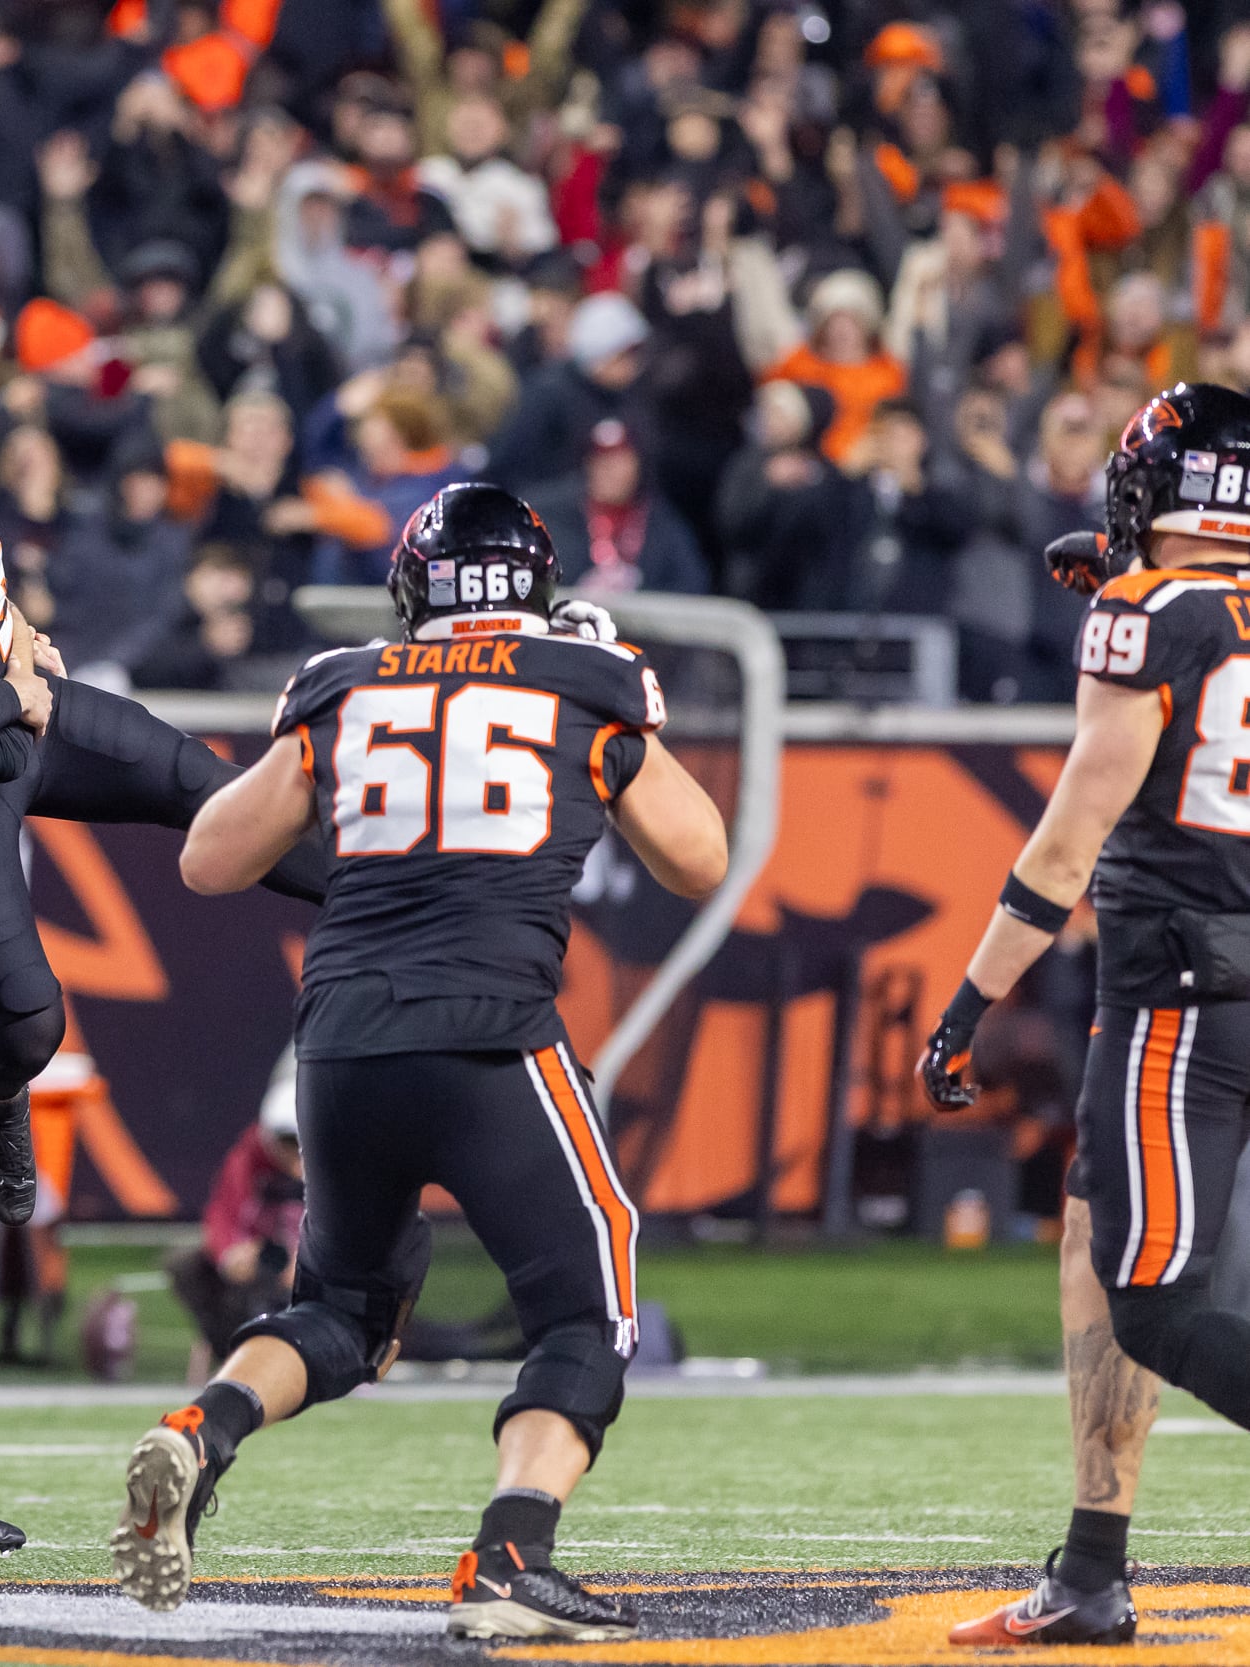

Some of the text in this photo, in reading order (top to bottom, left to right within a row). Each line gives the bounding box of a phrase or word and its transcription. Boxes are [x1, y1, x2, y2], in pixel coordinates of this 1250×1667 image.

[460, 563, 509, 602] 66
[378, 641, 521, 676] STARCK
[1081, 612, 1149, 675] 89
[332, 682, 560, 857] 66
[1176, 654, 1250, 837] 8
